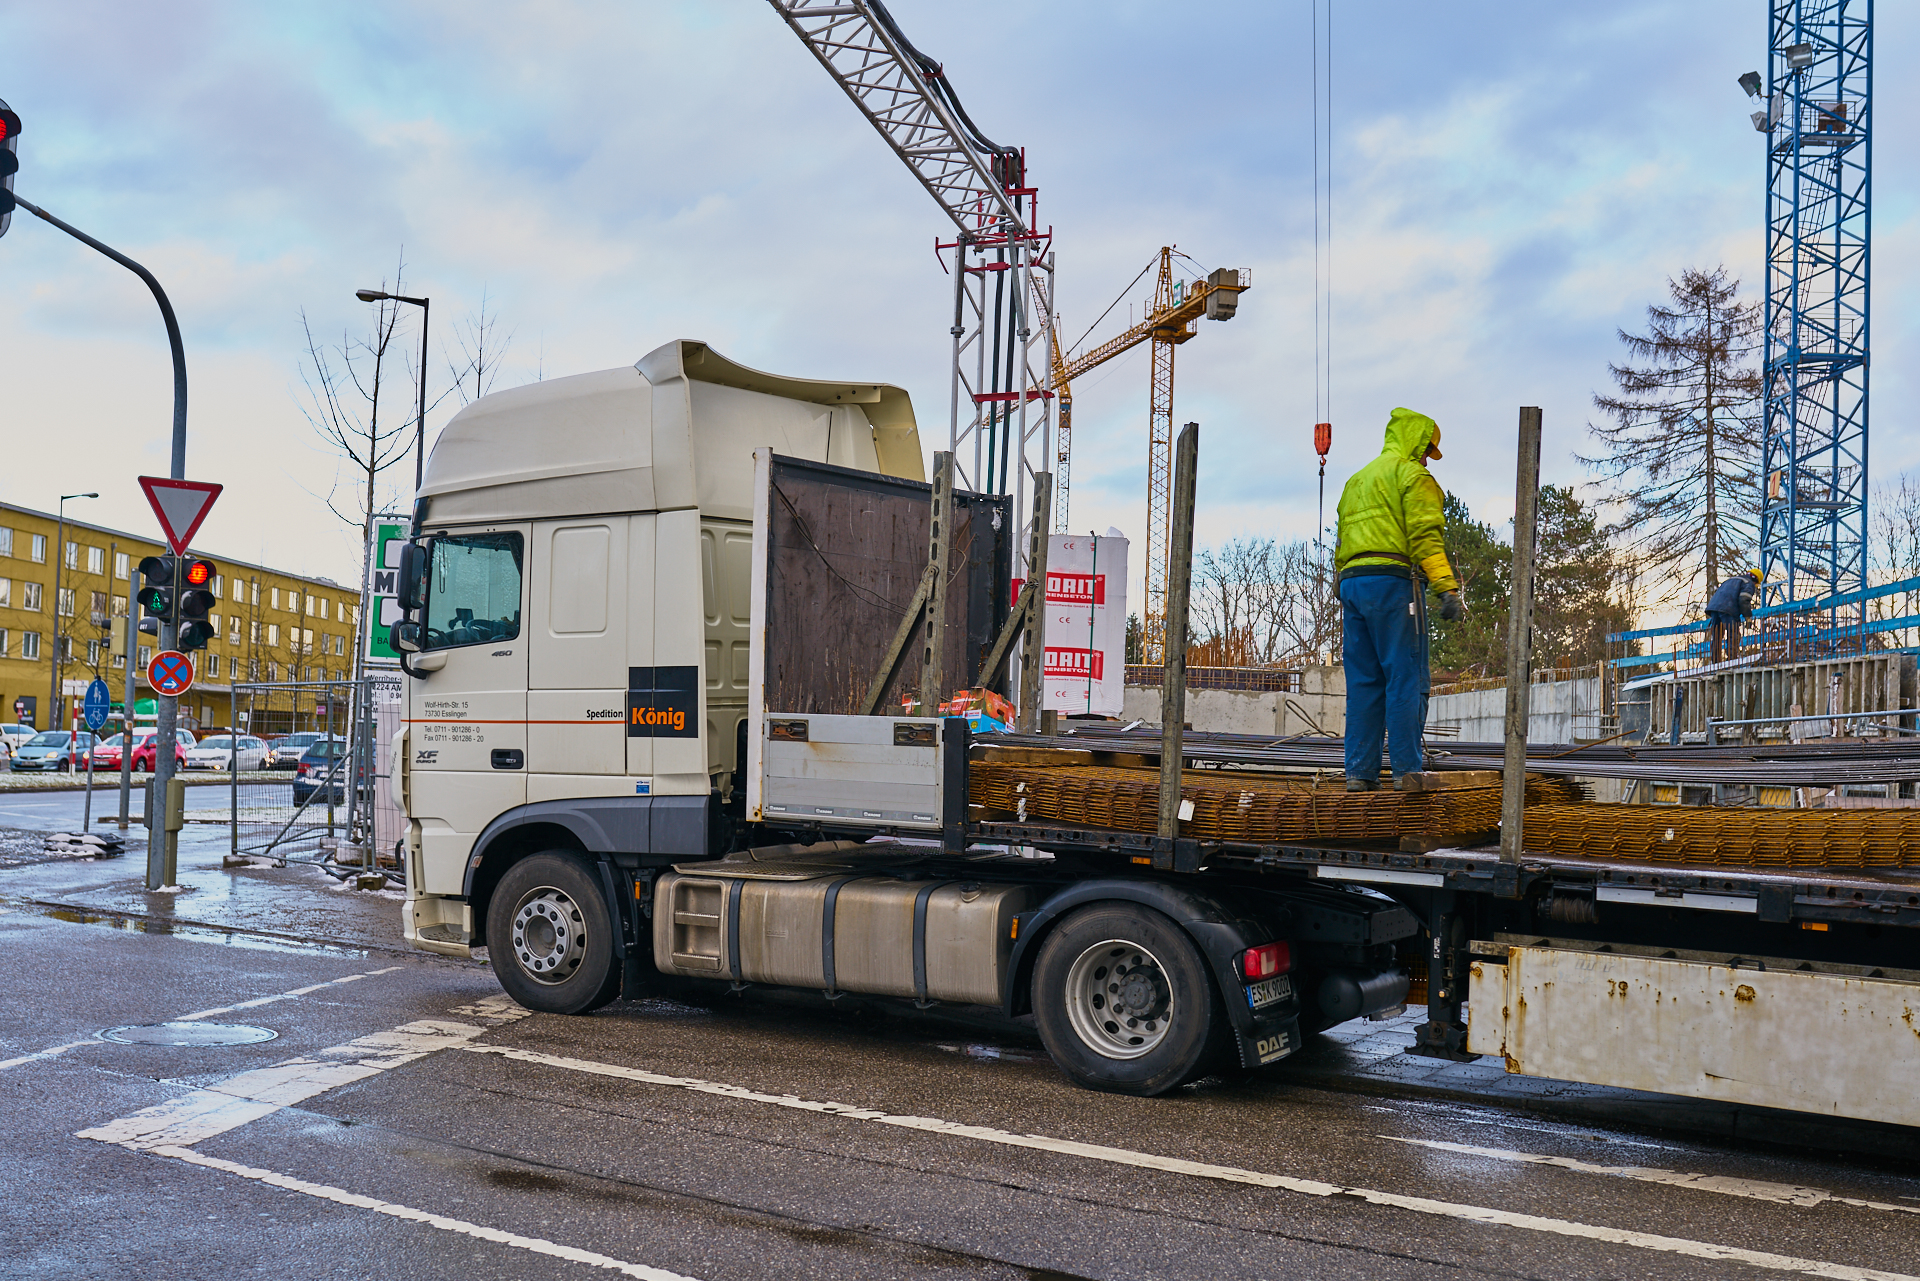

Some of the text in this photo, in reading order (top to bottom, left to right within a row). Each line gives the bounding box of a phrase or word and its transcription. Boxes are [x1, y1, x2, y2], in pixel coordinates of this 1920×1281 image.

[374, 571, 399, 594] M
[1047, 577, 1096, 594] ORIT
[377, 637, 388, 645] BA
[1045, 652, 1093, 668] ORIT
[442, 710, 467, 718] Esslingen
[586, 709, 623, 720] Spedition
[632, 707, 685, 730] König
[416, 750, 439, 759] XF
[1251, 986, 1263, 1003] ES
[1265, 981, 1272, 999] K
[1272, 976, 1289, 997] 9002
[1257, 1032, 1289, 1055] DAF
